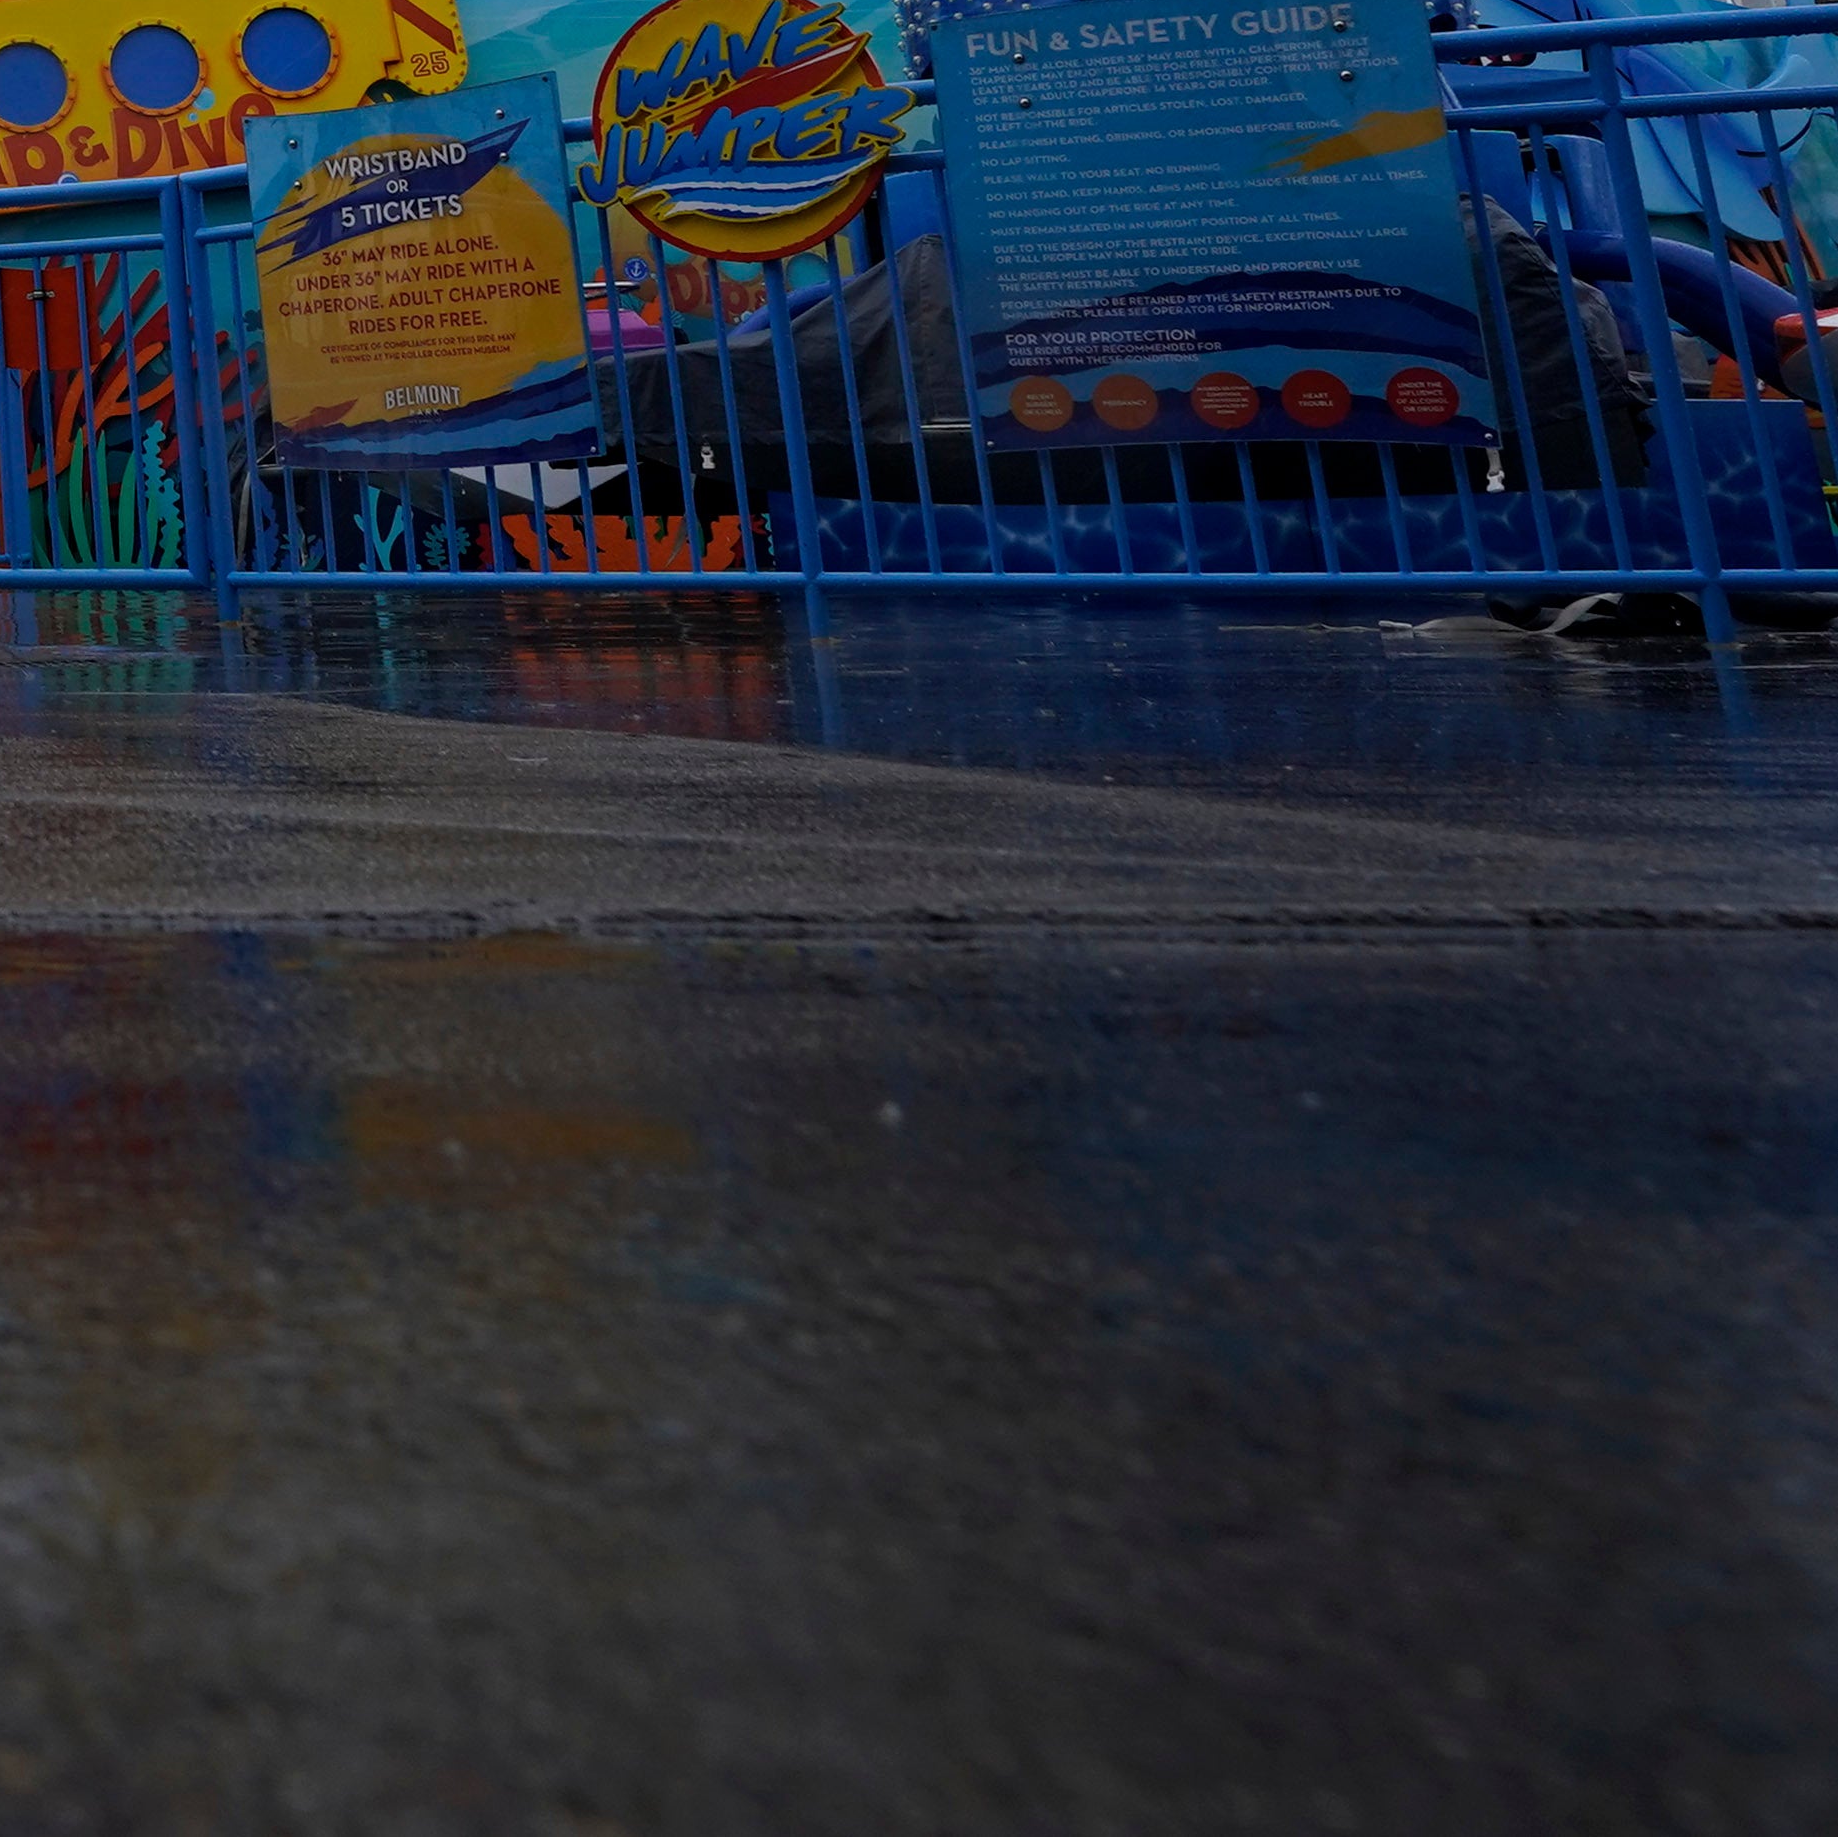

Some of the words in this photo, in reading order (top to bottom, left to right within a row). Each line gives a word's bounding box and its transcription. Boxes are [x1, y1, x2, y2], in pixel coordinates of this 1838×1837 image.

[966, 29, 1040, 59] FUN
[1049, 32, 1071, 52] &
[1079, 13, 1219, 50] SAFETY
[1231, 2, 1356, 37] GUIDE
[411, 51, 450, 77] 25
[65, 124, 110, 168] &
[577, 86, 915, 207] JUMPER
[324, 142, 468, 180] WRISTBAND
[385, 178, 409, 195] OR
[340, 207, 353, 228] 5
[360, 193, 463, 225] TICKETS
[988, 209, 1005, 220] NO
[1007, 207, 1061, 219] HANGING
[1063, 205, 1086, 216] OUT
[1089, 204, 1106, 215] OF
[1107, 203, 1131, 214] THE
[1133, 202, 1160, 213] RIDE
[1163, 201, 1176, 211] AT
[1180, 200, 1203, 211] ANY
[322, 250, 347, 269] 36"
[351, 246, 385, 266] MAY
[390, 242, 429, 261] RIDE
[434, 234, 498, 257] ALONE.
[993, 244, 1016, 255] DUE
[1018, 243, 1034, 253] TO
[1036, 242, 1058, 253] THE
[1061, 240, 1103, 252] DESIGN
[1105, 239, 1121, 250] OF
[1123, 238, 1147, 249] THE
[1265, 229, 1363, 243] EXCEPTIONALLY
[1366, 227, 1408, 239] LARGE
[995, 254, 1012, 265] OR
[1013, 253, 1039, 264] TALL
[1042, 251, 1086, 263] PEOPLE
[1087, 250, 1112, 261] MAY
[1113, 249, 1139, 260] NOT
[1141, 248, 1157, 259] BE
[1159, 247, 1188, 258] ABLE
[1190, 246, 1208, 257] TO
[296, 271, 351, 291] UNDER
[354, 269, 381, 287] 36"
[385, 265, 420, 284] MAY
[426, 262, 466, 281] RIDE
[469, 258, 517, 277] WITH
[523, 256, 535, 273] A
[997, 272, 1017, 283] ALL
[1019, 270, 1059, 282] RIDERS
[1061, 269, 1090, 280] MUST
[1094, 268, 1109, 279] BE
[1112, 267, 1140, 278] ABLE
[1143, 267, 1160, 277] TO
[1162, 263, 1241, 276] UNDERSTAND
[1243, 262, 1269, 273] AND
[1271, 260, 1333, 272] PROPERLY
[1337, 259, 1361, 270] USE
[278, 293, 384, 317] CHAPERONE.
[388, 288, 443, 308] ADULT
[448, 279, 561, 304] CHAPERONE
[1000, 282, 1020, 293] THE
[1022, 281, 1064, 292] SAFETY
[1001, 300, 1042, 311] PEOPLE
[1045, 298, 1091, 309] UNABLE
[1092, 297, 1109, 308] TO
[1111, 297, 1126, 307] BE
[1128, 295, 1185, 306] RETAINED
[1187, 294, 1201, 304] BY
[1204, 293, 1229, 304] THE
[1231, 291, 1275, 303] SAFETY
[1278, 289, 1352, 301] RESTRAINTS
[1354, 288, 1380, 299] DUE
[1383, 287, 1402, 298] TO
[349, 316, 395, 335] RIDES
[400, 313, 434, 332] FOR
[439, 310, 487, 329] FREE.
[1083, 307, 1125, 318] PLEASE
[1127, 306, 1148, 317] SEE
[1151, 304, 1214, 316] OPERATOR
[1217, 304, 1242, 314] FOR
[1005, 332, 1037, 346] FOR
[1041, 331, 1086, 345] YOUR
[1090, 328, 1196, 344] PROTECTION
[1008, 346, 1032, 357] THIS
[1034, 346, 1060, 356] RIDE
[1062, 345, 1072, 355] IS
[1074, 345, 1098, 355] NOT
[1101, 342, 1195, 354] RECOMMENDED
[1196, 341, 1222, 352] FOR
[1009, 356, 1051, 367] GUESTS
[1053, 355, 1084, 366] WITH
[1085, 355, 1122, 365] THESE
[384, 385, 461, 410] BELMONT
